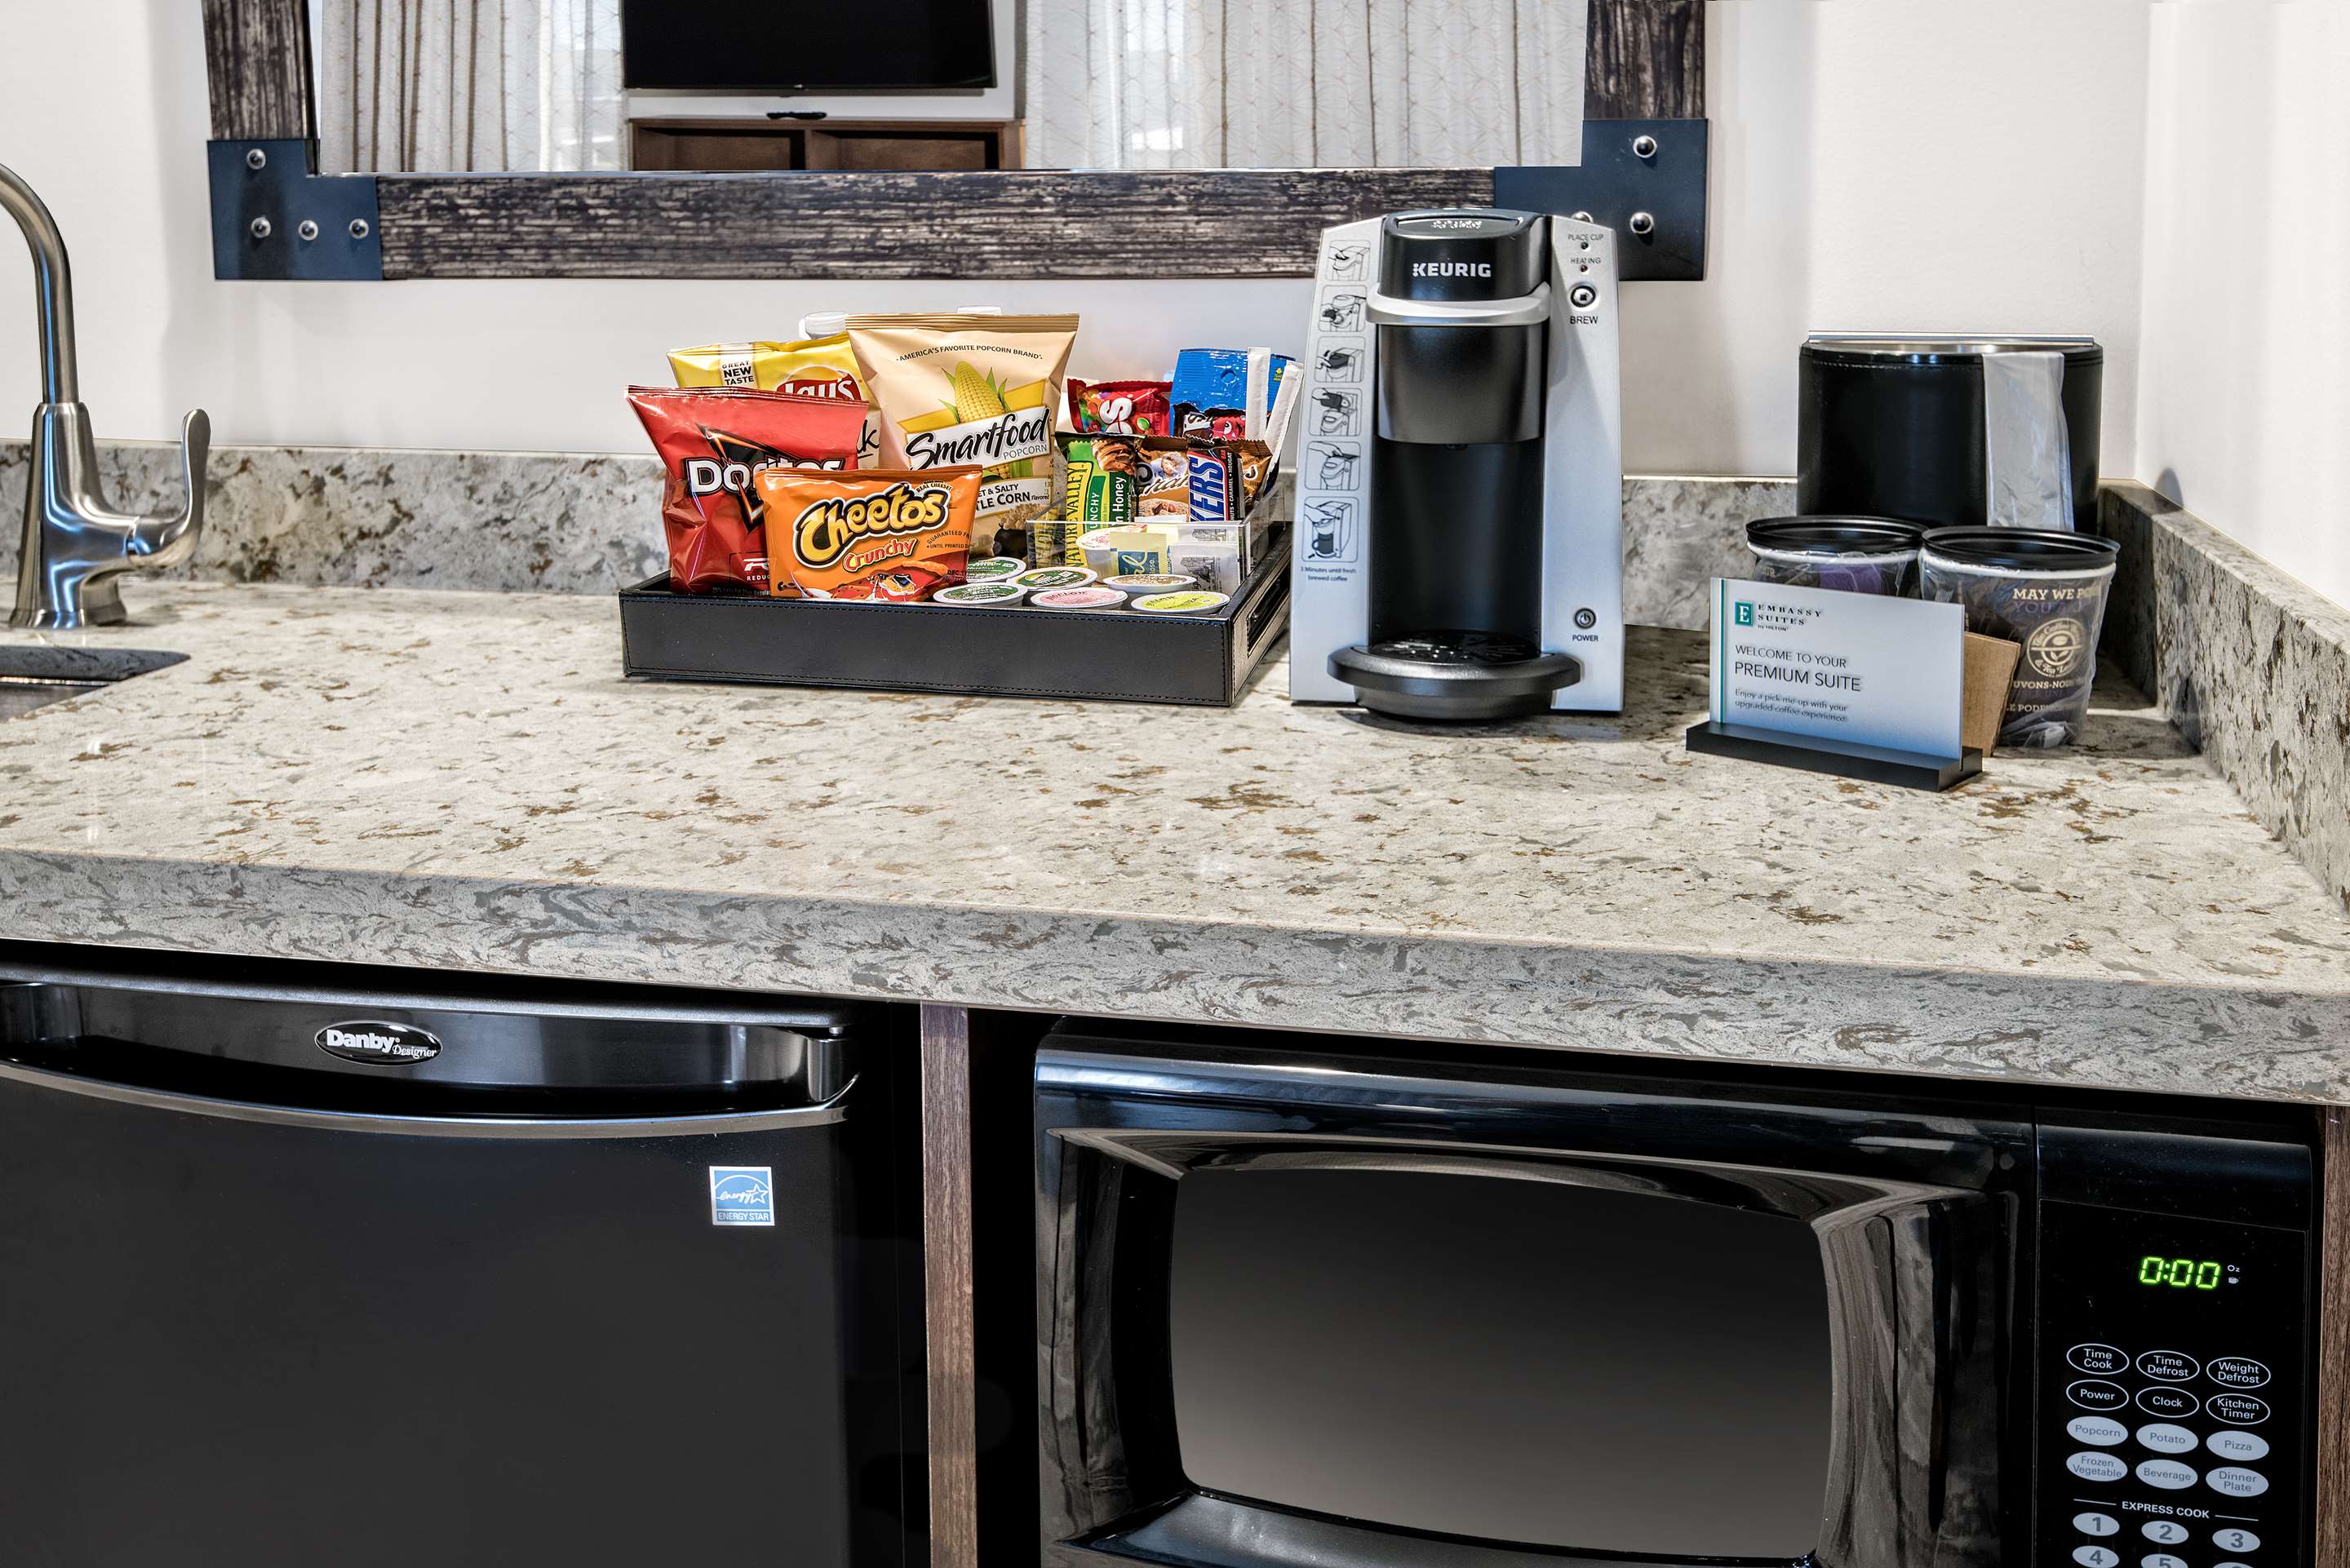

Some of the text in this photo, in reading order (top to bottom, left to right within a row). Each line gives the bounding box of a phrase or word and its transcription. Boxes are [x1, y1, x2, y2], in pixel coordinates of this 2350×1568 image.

[1412, 262, 1492, 277] KEURIG
[1569, 315, 1598, 325] BREW
[899, 346, 939, 361] AMERICA'S
[939, 344, 975, 352] FAVORITE
[976, 345, 1012, 354] POPCORN
[721, 361, 750, 369] GREAT
[723, 366, 752, 378] NEW
[725, 375, 755, 385] TASTE
[905, 405, 1051, 470] Smartfood
[1003, 444, 1048, 460] POPCORN
[995, 483, 1019, 494] SALTY
[1066, 467, 1088, 516] VALLEY
[1112, 476, 1127, 512] Honey
[996, 491, 1031, 505] CORN
[794, 483, 948, 569] Cheetos
[842, 537, 917, 573] Crunchy
[2012, 587, 2049, 600] MAY
[2052, 588, 2075, 600] WE
[1758, 604, 1822, 618] EMBASSY
[1758, 613, 1806, 627] SUITES
[1572, 634, 1599, 643] POWER
[1735, 644, 1847, 669] WELCOME TO YOUR
[1735, 661, 1861, 692] PREMIUM SUITE
[1735, 688, 1757, 699] Enjoy
[1810, 700, 1828, 709] with
[1829, 704, 1848, 712] your
[1735, 700, 1774, 712] upgraded
[1774, 705, 1800, 716] coffee
[326, 1029, 395, 1053] Danby
[392, 1043, 437, 1059] Designer
[718, 1212, 769, 1221] ENERGY STAR
[2139, 1256, 2222, 1290] 0:00
[2083, 1348, 2113, 1360] Time
[2153, 1355, 2183, 1366] Time
[2083, 1358, 2113, 1370] Cook
[2147, 1365, 2188, 1377] Defrost
[2218, 1362, 2259, 1375] Weight
[2218, 1371, 2259, 1384] Defrost
[2080, 1389, 2116, 1401] Power
[2153, 1396, 2183, 1408] Clock
[2217, 1398, 2259, 1411] Kitchen
[2220, 1408, 2255, 1420] Timer
[2074, 1424, 2121, 1438] Popcorn
[2149, 1432, 2186, 1445] Potato
[2224, 1440, 2253, 1451] Pizza
[2080, 1455, 2114, 1468] Frozen
[2073, 1464, 2122, 1478] Vegetable
[2144, 1468, 2192, 1482] Beverage
[2219, 1471, 2258, 1482] Dinner
[2224, 1481, 2252, 1492] Plate
[2122, 1501, 2210, 1519] EXPRESS COOK
[2091, 1517, 2102, 1532] 1
[2159, 1524, 2173, 1540] 2
[2230, 1532, 2244, 1548] 3
[2089, 1550, 2103, 1565] 4
[2158, 1557, 2171, 1568] 5
